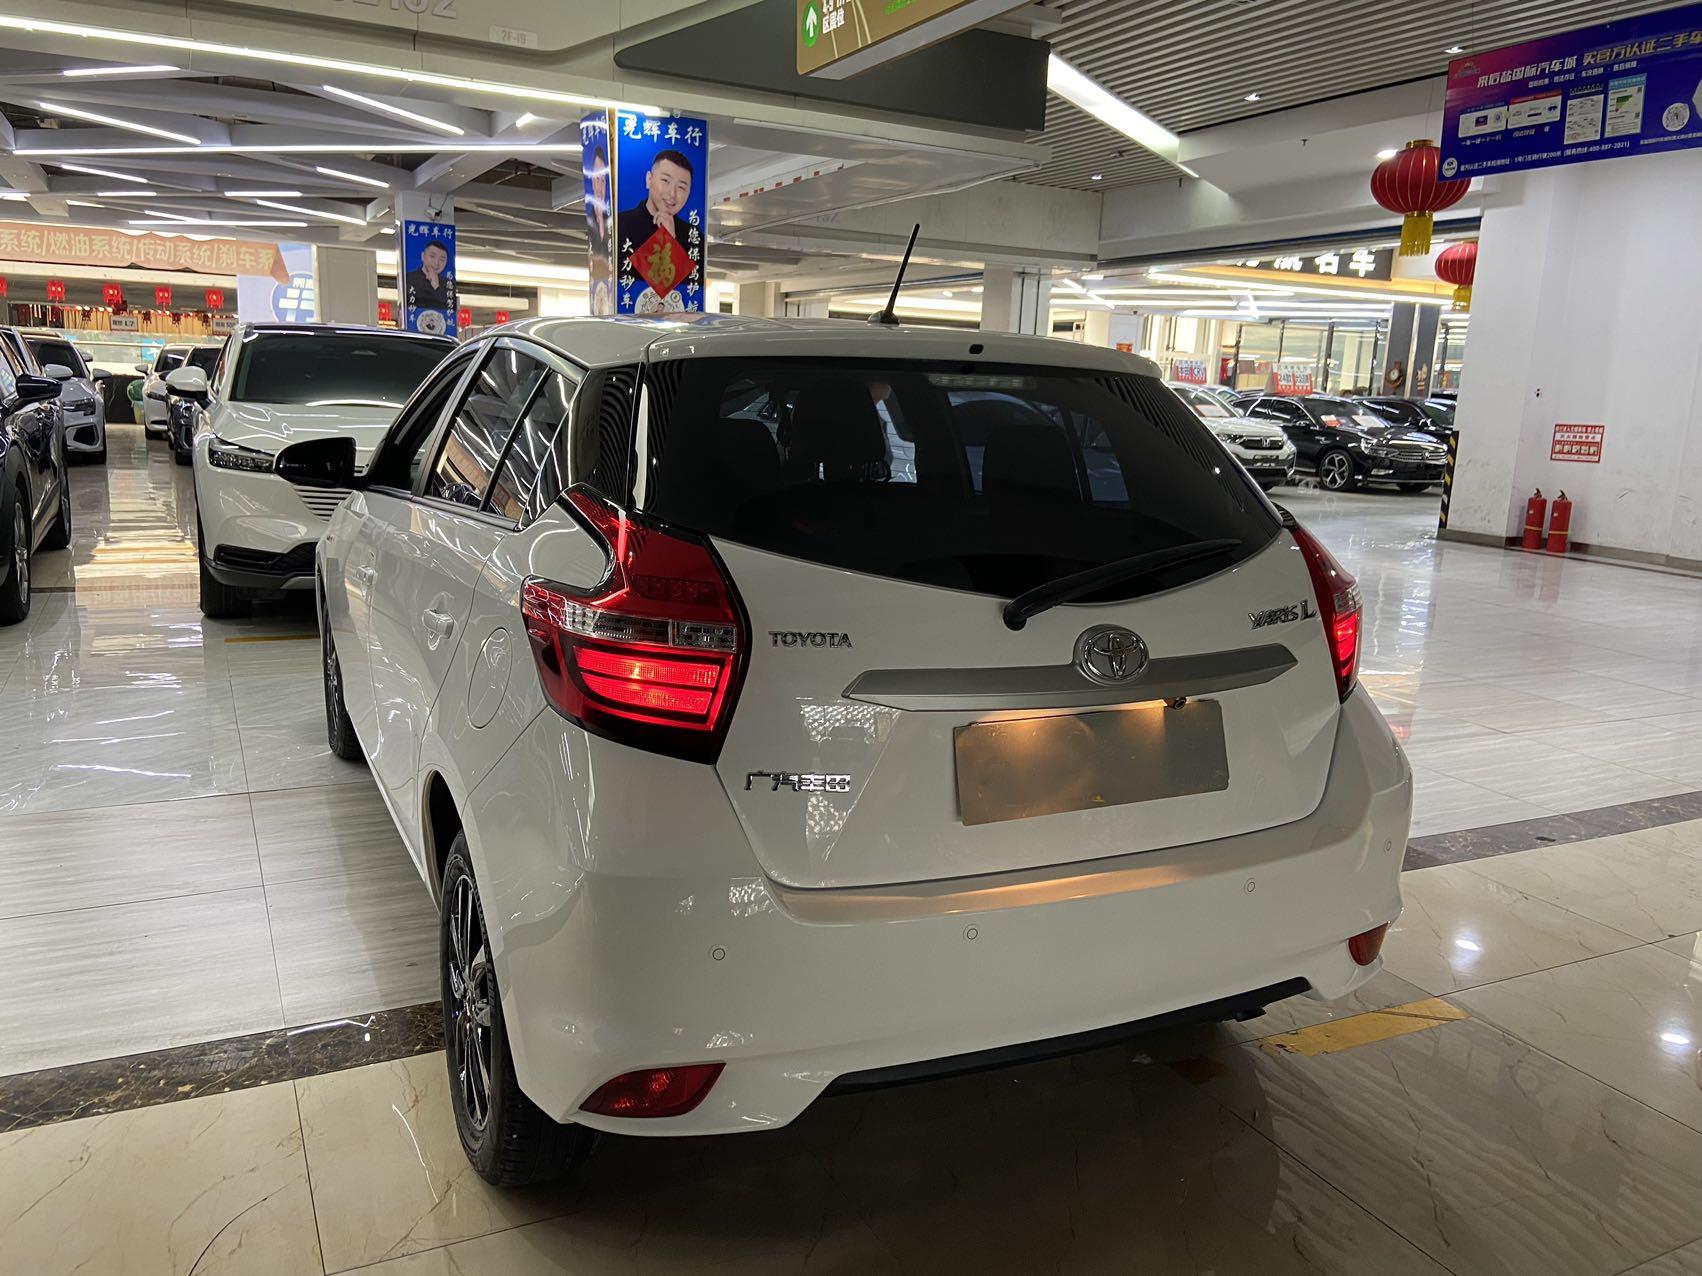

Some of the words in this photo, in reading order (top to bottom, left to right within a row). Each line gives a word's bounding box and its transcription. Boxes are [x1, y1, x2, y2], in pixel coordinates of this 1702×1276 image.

[1300, 600, 1317, 620] L
[768, 631, 853, 648] TOYOTA
[744, 770, 851, 793] 广汽丰田
